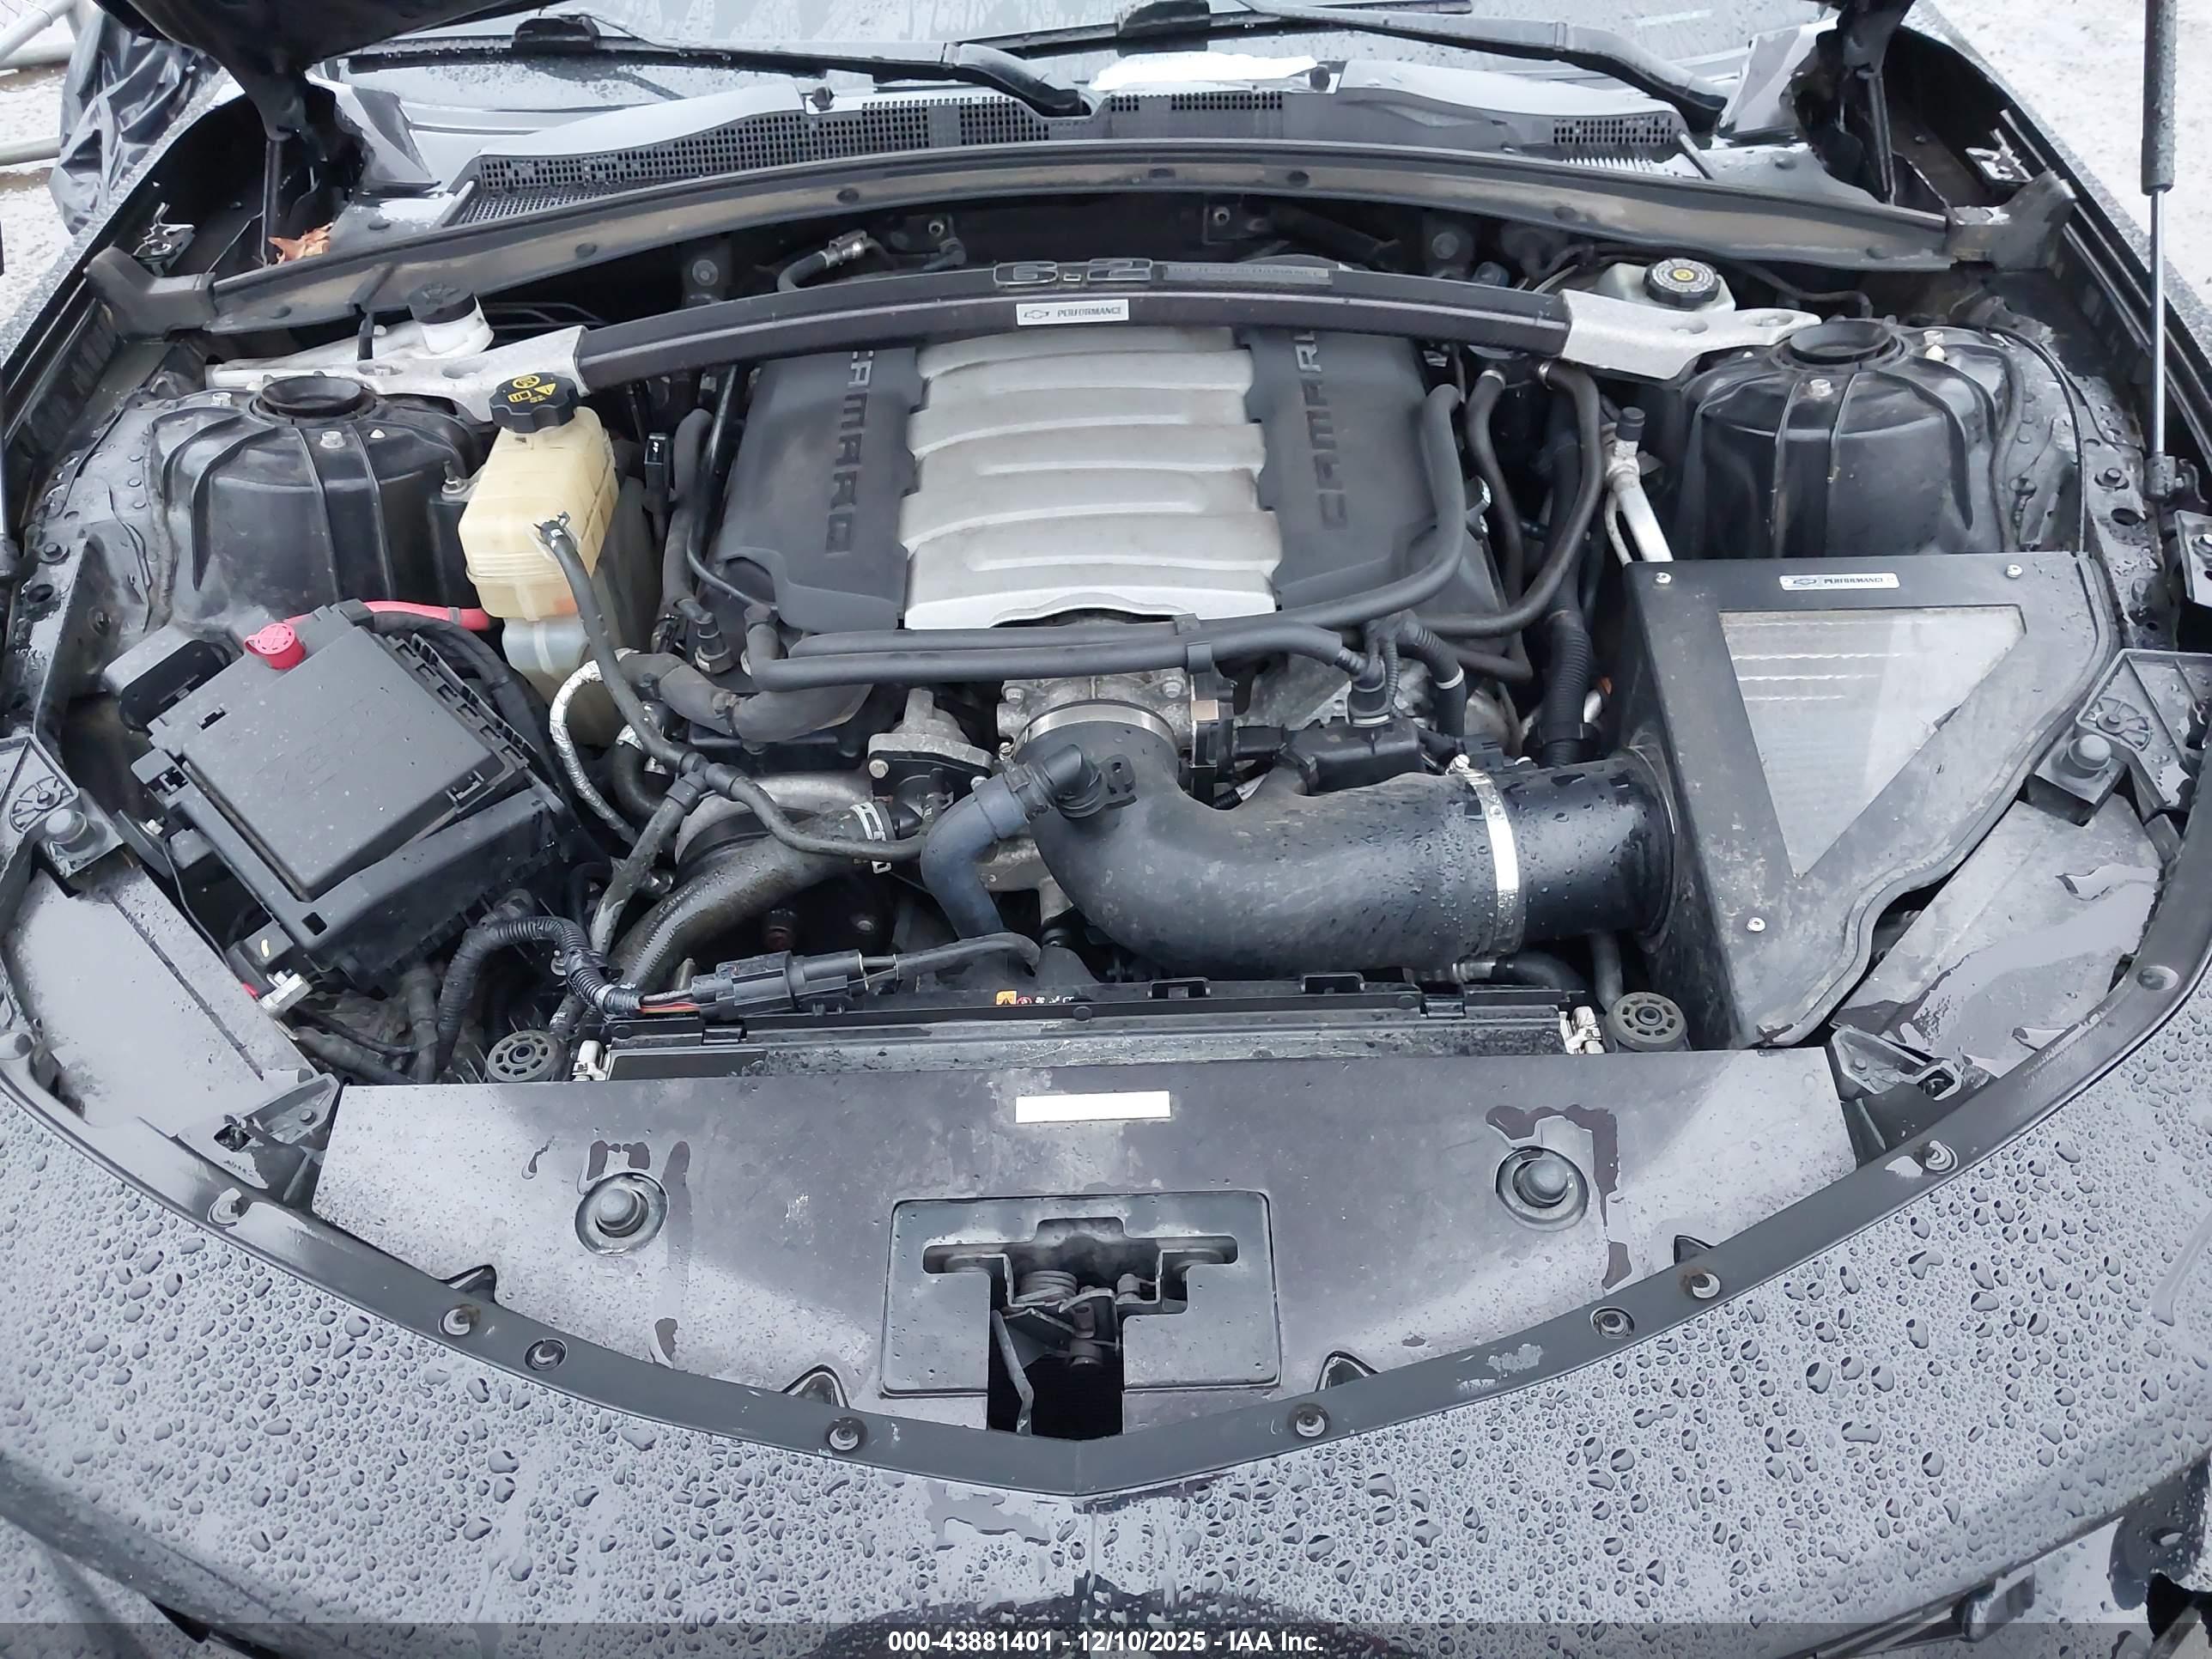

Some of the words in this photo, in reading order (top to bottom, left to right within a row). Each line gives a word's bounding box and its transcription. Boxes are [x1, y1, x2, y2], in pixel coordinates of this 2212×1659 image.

[1057, 307, 1121, 318] PERFORMANCE
[823, 350, 874, 551] AMARO
[1294, 331, 1348, 530] CAMAR
